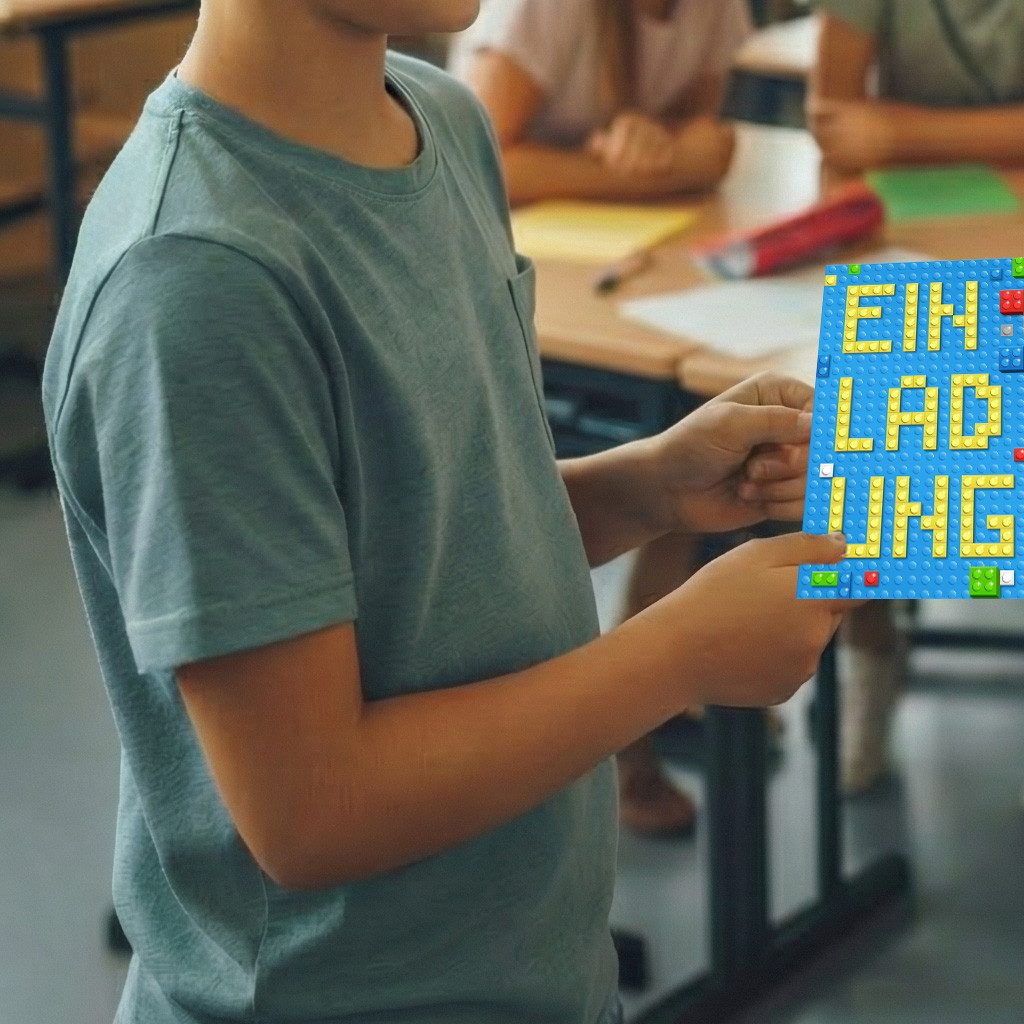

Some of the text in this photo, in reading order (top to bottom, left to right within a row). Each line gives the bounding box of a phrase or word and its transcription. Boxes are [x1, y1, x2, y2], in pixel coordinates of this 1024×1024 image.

[842, 281, 978, 354] EIN
[834, 373, 1002, 452] LAD
[828, 474, 1015, 559] UNG
